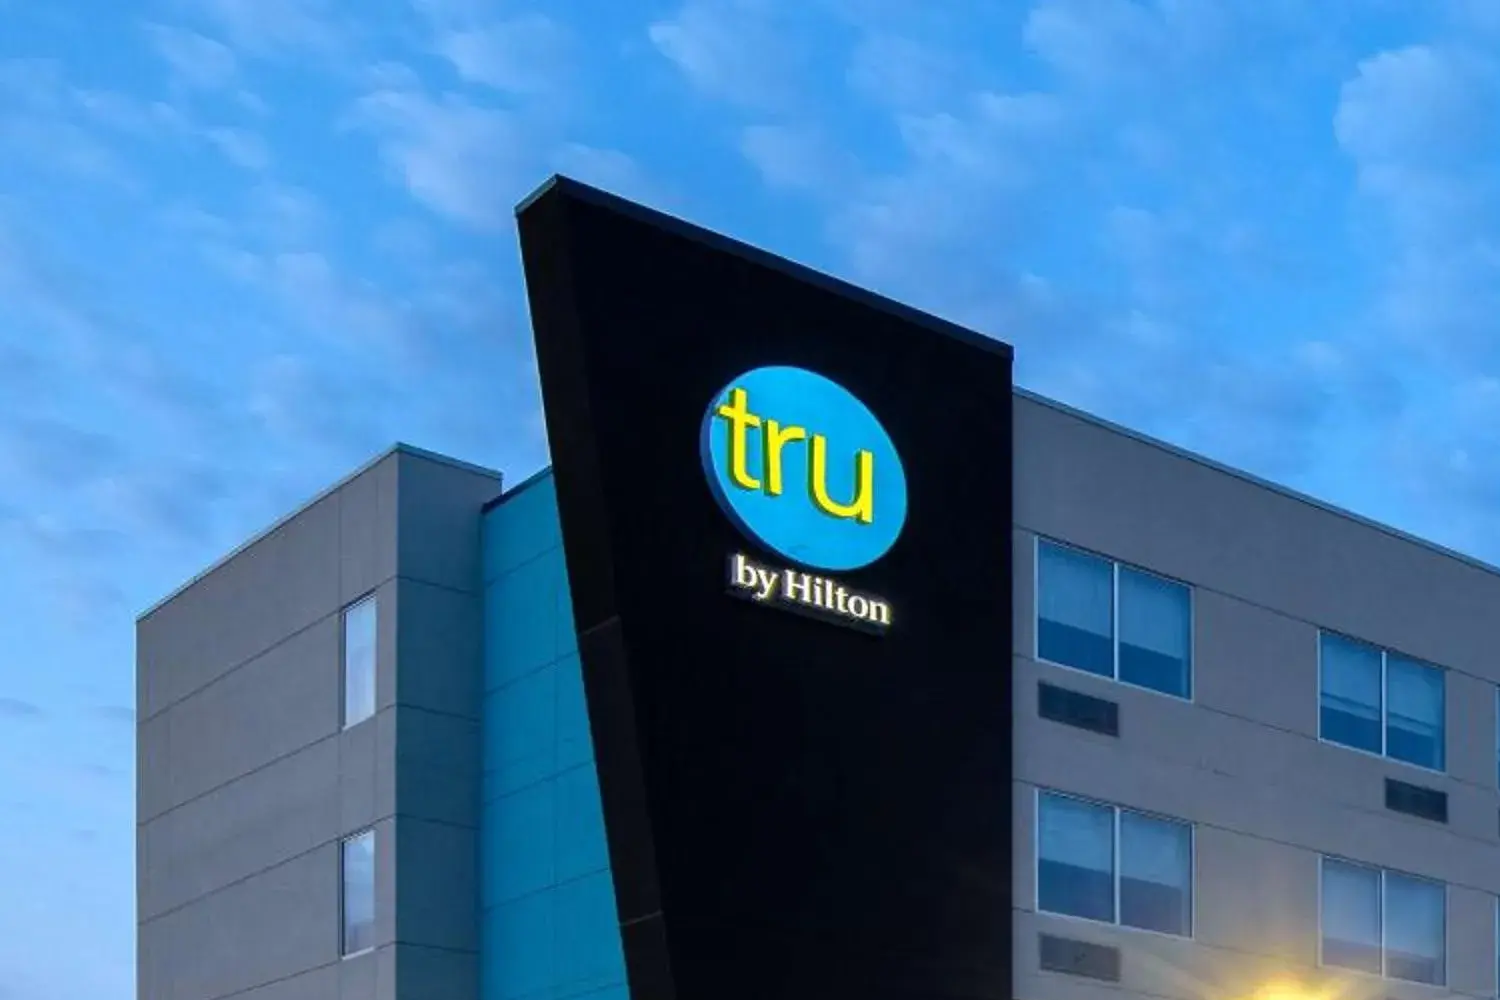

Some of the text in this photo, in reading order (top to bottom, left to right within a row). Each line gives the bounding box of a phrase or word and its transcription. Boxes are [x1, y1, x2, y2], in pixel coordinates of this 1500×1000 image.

[714, 386, 874, 524] tru
[731, 553, 891, 626] by Hilton
